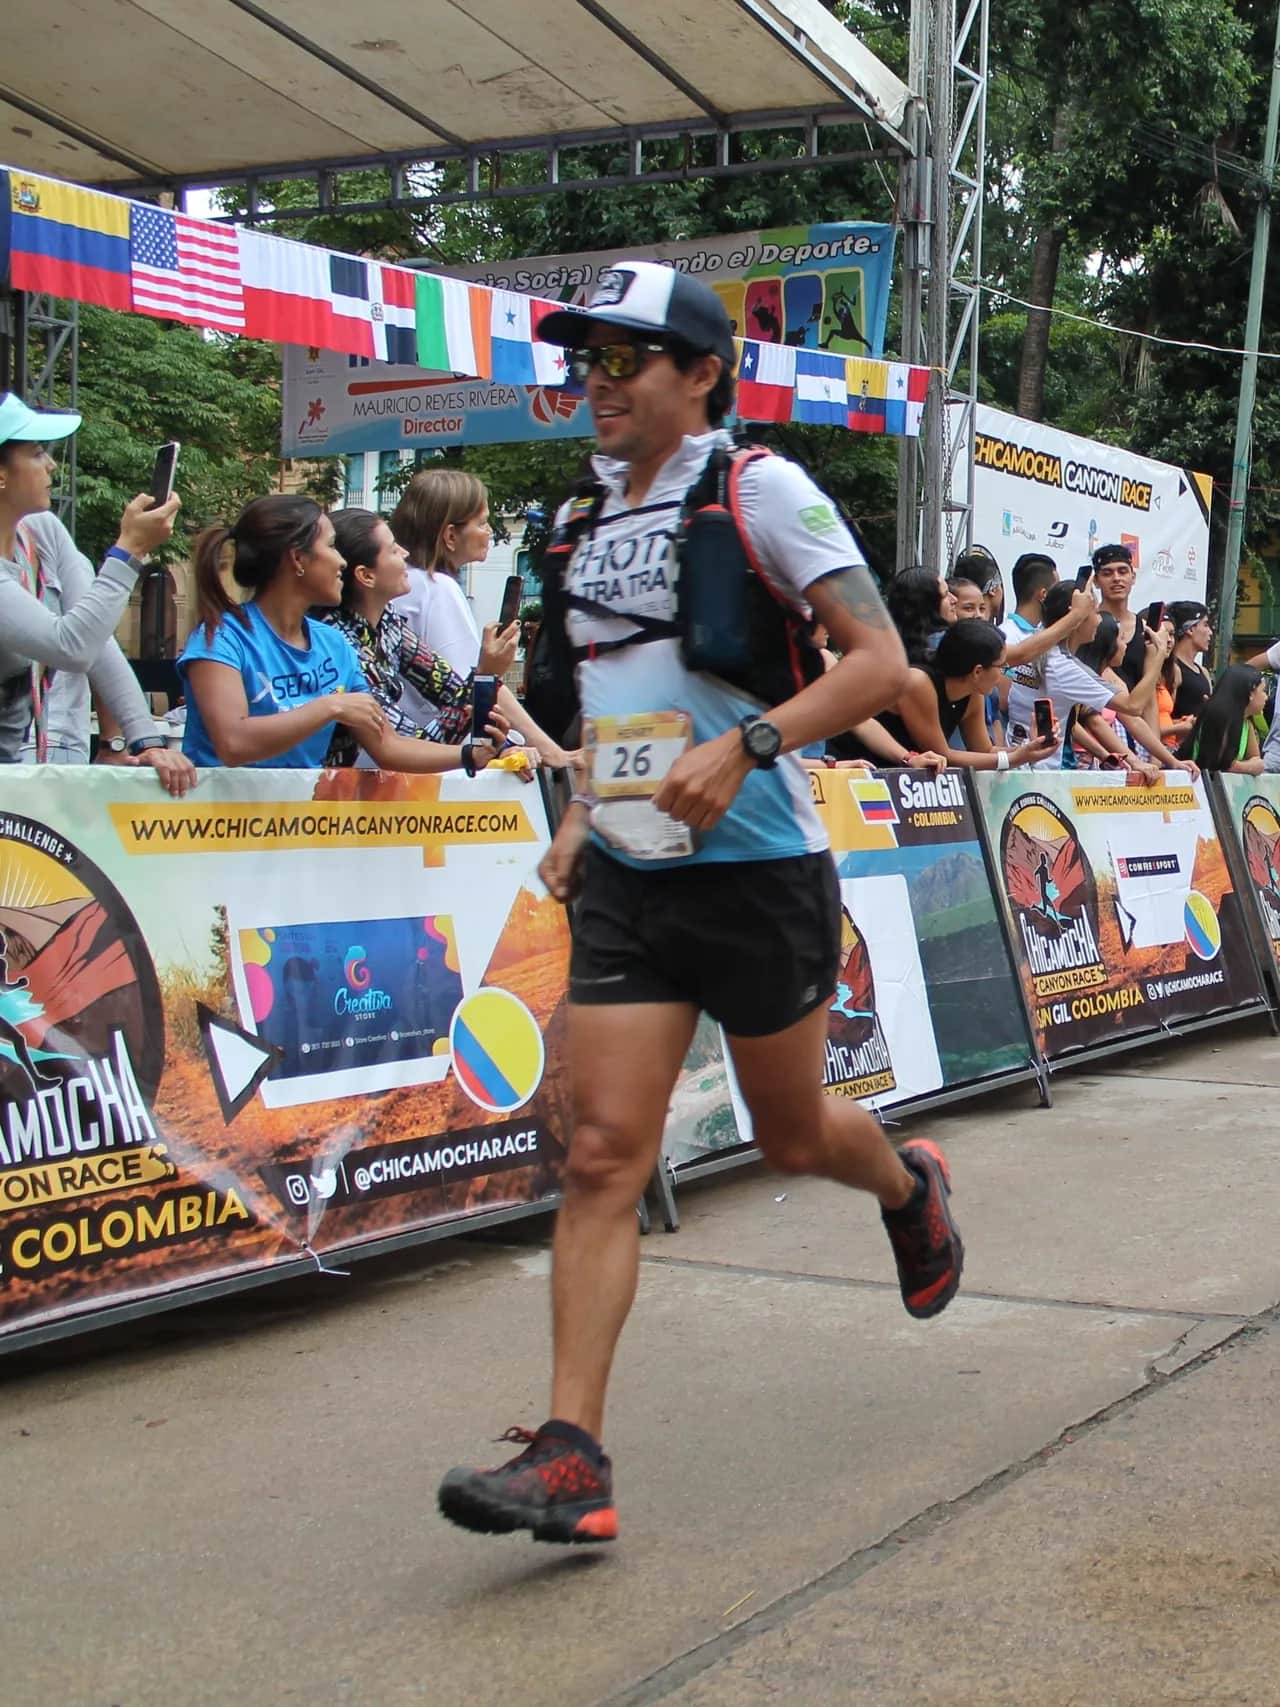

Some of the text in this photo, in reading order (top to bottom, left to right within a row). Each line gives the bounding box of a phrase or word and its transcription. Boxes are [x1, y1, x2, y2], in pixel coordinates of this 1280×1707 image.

[515, 264, 593, 291] Social
[728, 247, 755, 268] el
[758, 236, 880, 266] Deporte.
[353, 387, 519, 417] MAURICIO REYES RIVERA
[403, 417, 464, 436] Director
[1065, 464, 1120, 500] CANYON
[1122, 481, 1151, 508] RACE
[272, 658, 339, 700] SERIES
[611, 744, 653, 778] 26
[899, 773, 965, 809] SanGil
[0, 818, 65, 858] CHALLENGE
[131, 814, 519, 841] WWW.CHICAMOCHACANYONRACE.COM
[913, 811, 957, 827] COLOMBIA
[1020, 904, 1100, 975] CHICAMOCHA
[1039, 968, 1098, 994] CANYON RACE
[354, 1011, 376, 1021] STORE
[1053, 1003, 1072, 1025] GIL
[1071, 987, 1145, 1019] COLOMBIA
[58, 1153, 143, 1191] RACE
[353, 1131, 537, 1191] @CHICAMOCHARACE
[11, 1187, 249, 1269] COLOMBIA
